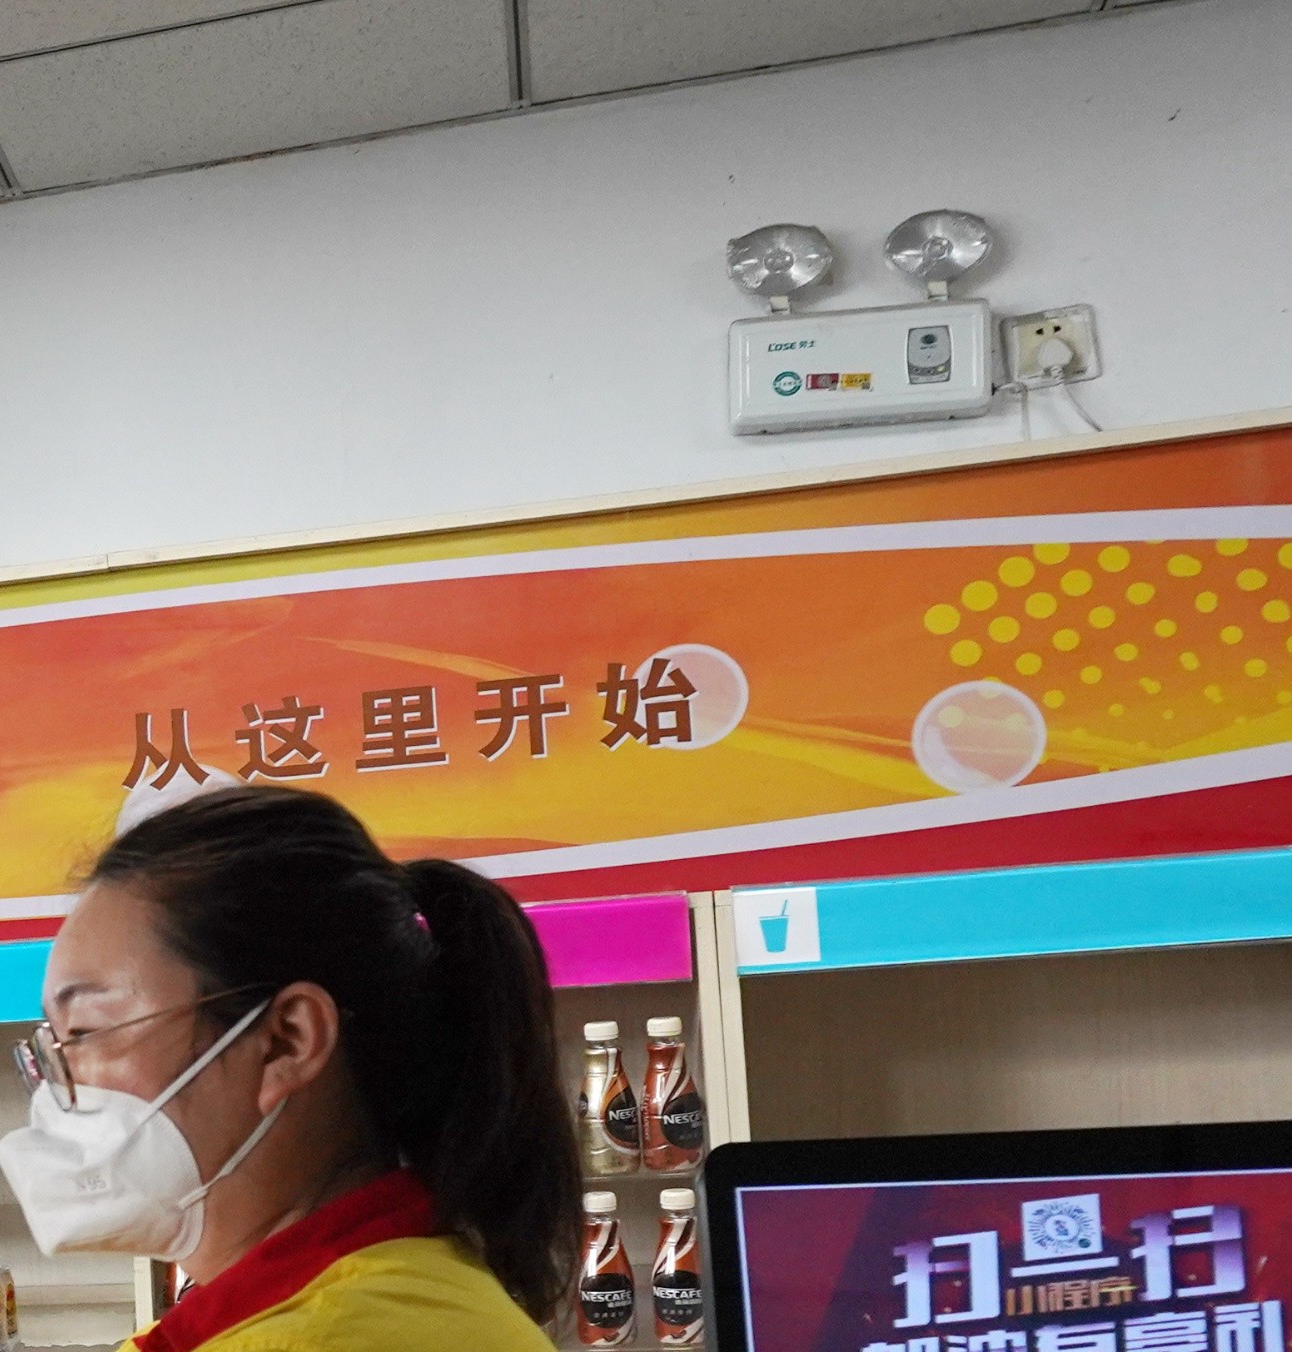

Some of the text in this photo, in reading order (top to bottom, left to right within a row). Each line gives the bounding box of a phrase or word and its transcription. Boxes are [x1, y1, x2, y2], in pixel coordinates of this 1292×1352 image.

[122, 658, 698, 792] 从这里开始
[893, 1204, 1247, 1329] 扫一扫
[1007, 1276, 1137, 1317] 小程序
